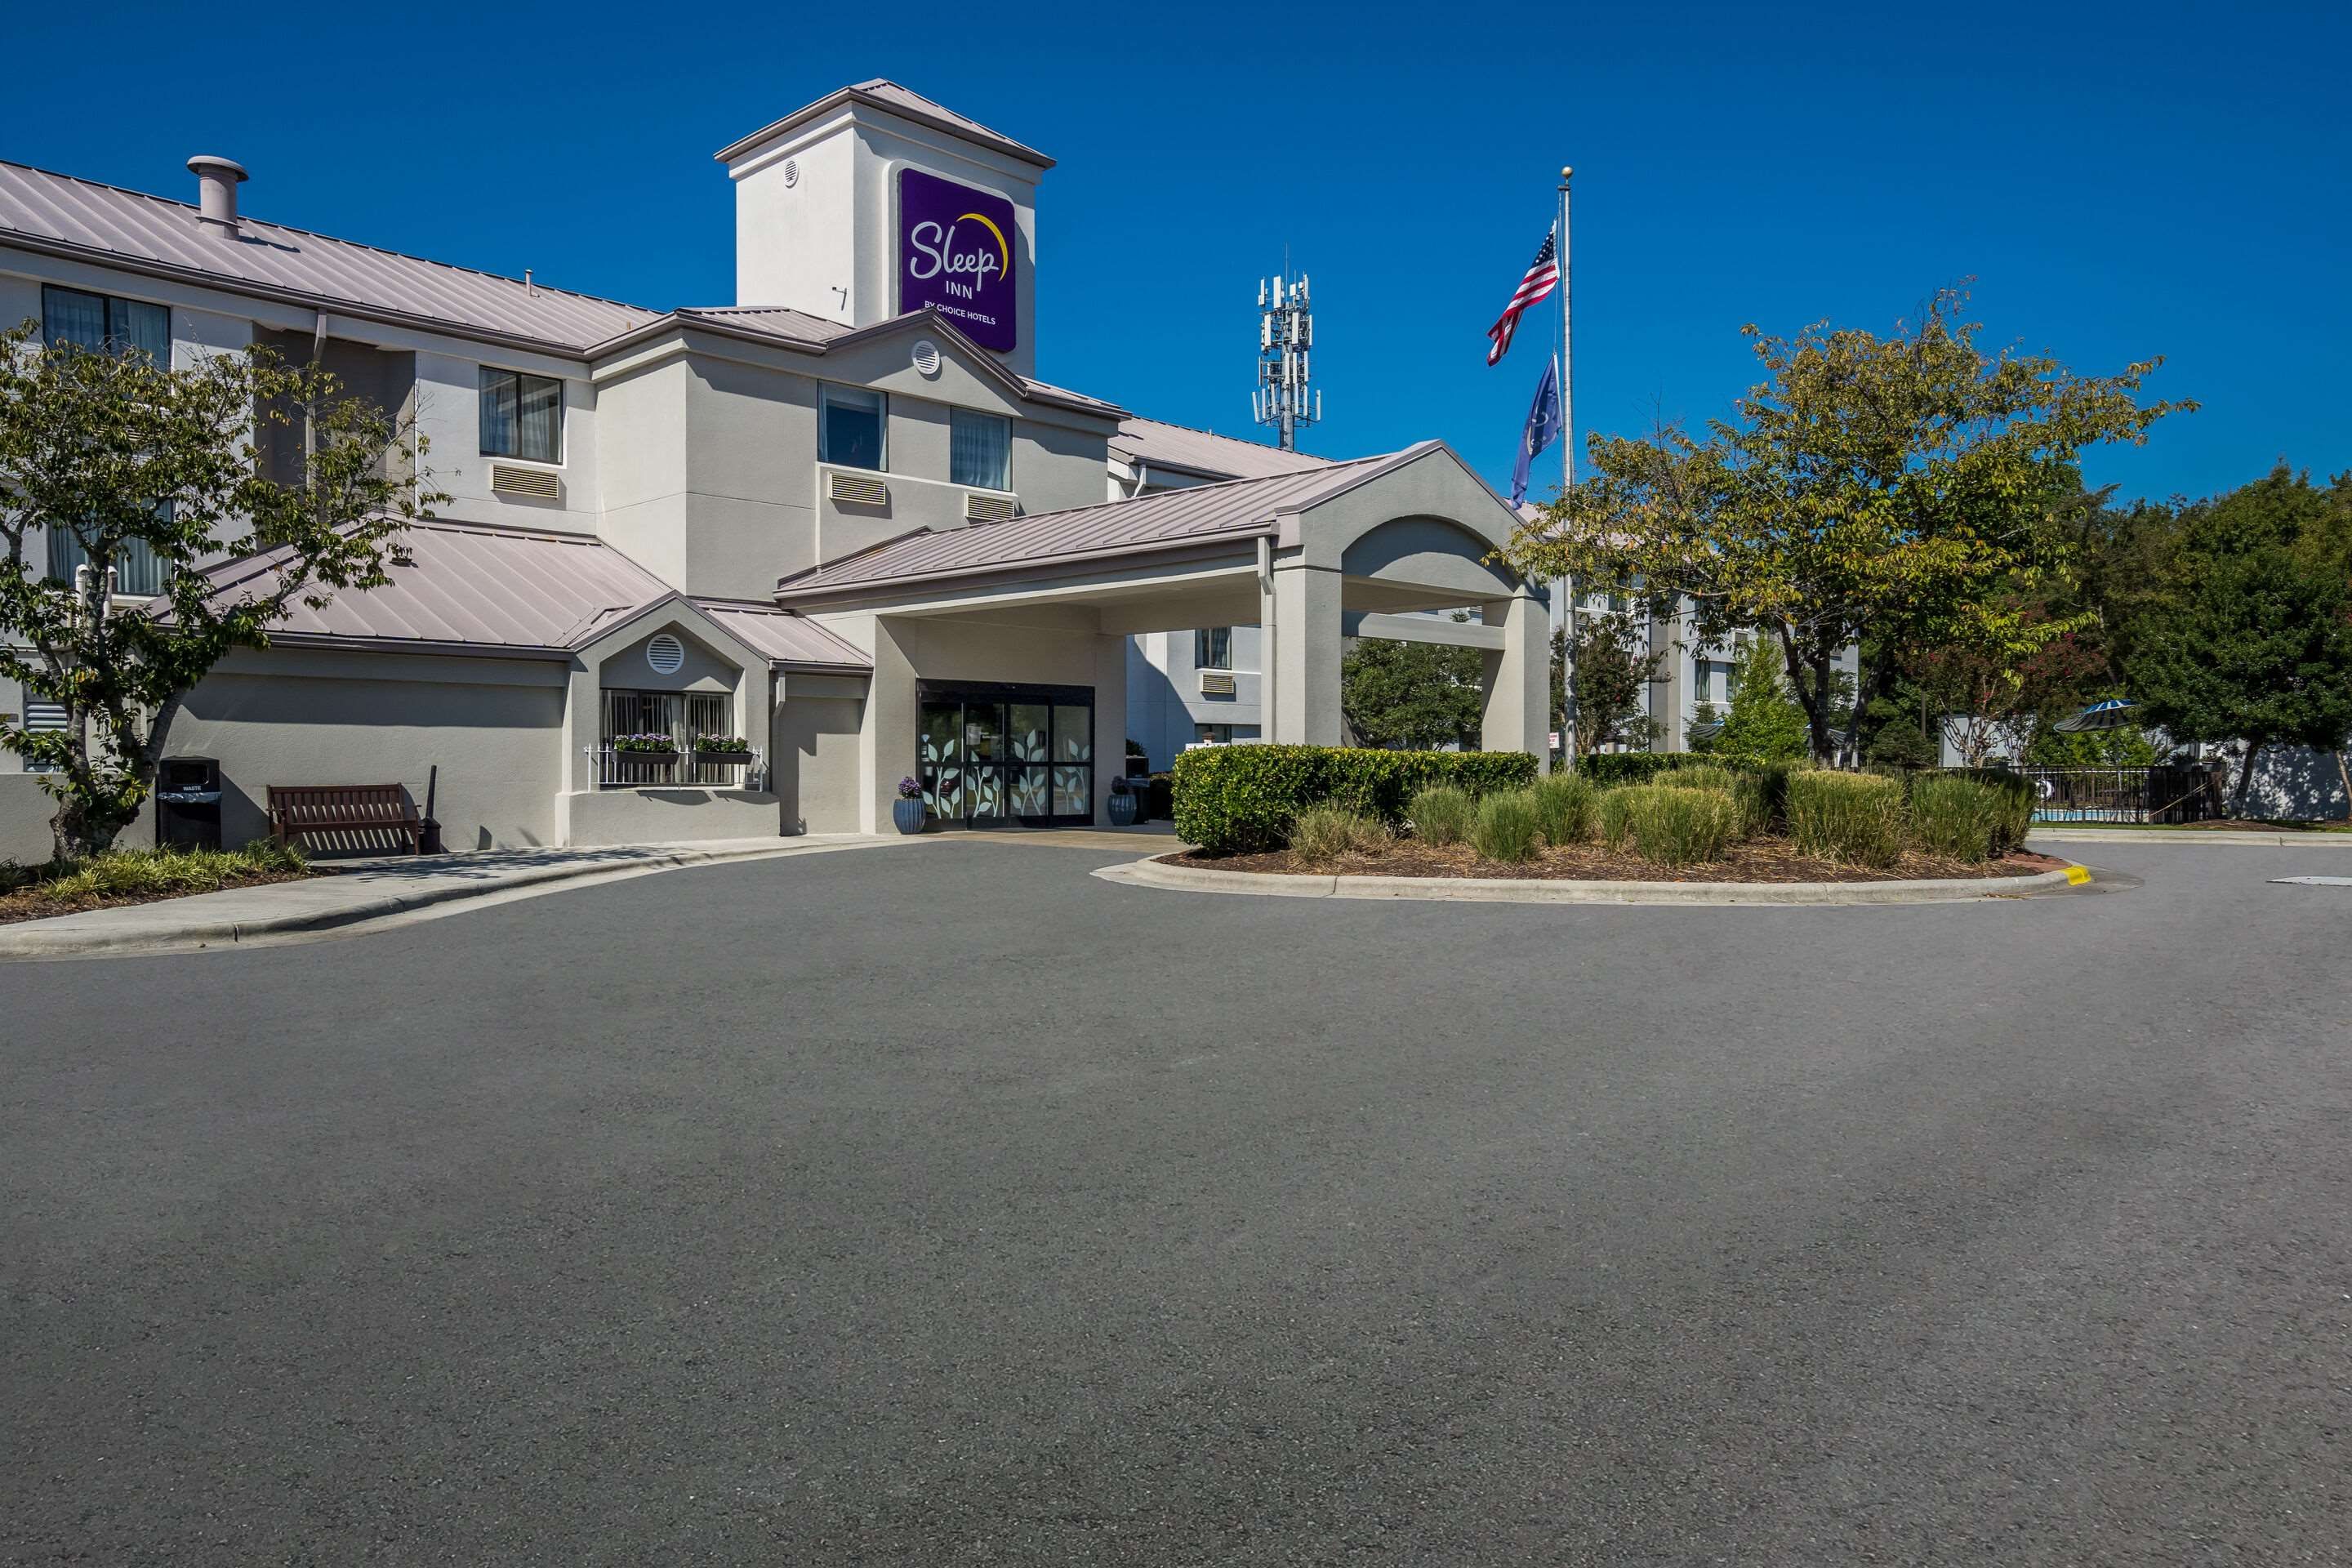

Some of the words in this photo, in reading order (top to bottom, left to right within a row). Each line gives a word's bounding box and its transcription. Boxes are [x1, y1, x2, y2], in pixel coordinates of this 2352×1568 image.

[910, 220, 1000, 292] Sleep
[946, 280, 973, 300] INN
[937, 304, 966, 318] CHOICE
[967, 311, 996, 325] HOTELS
